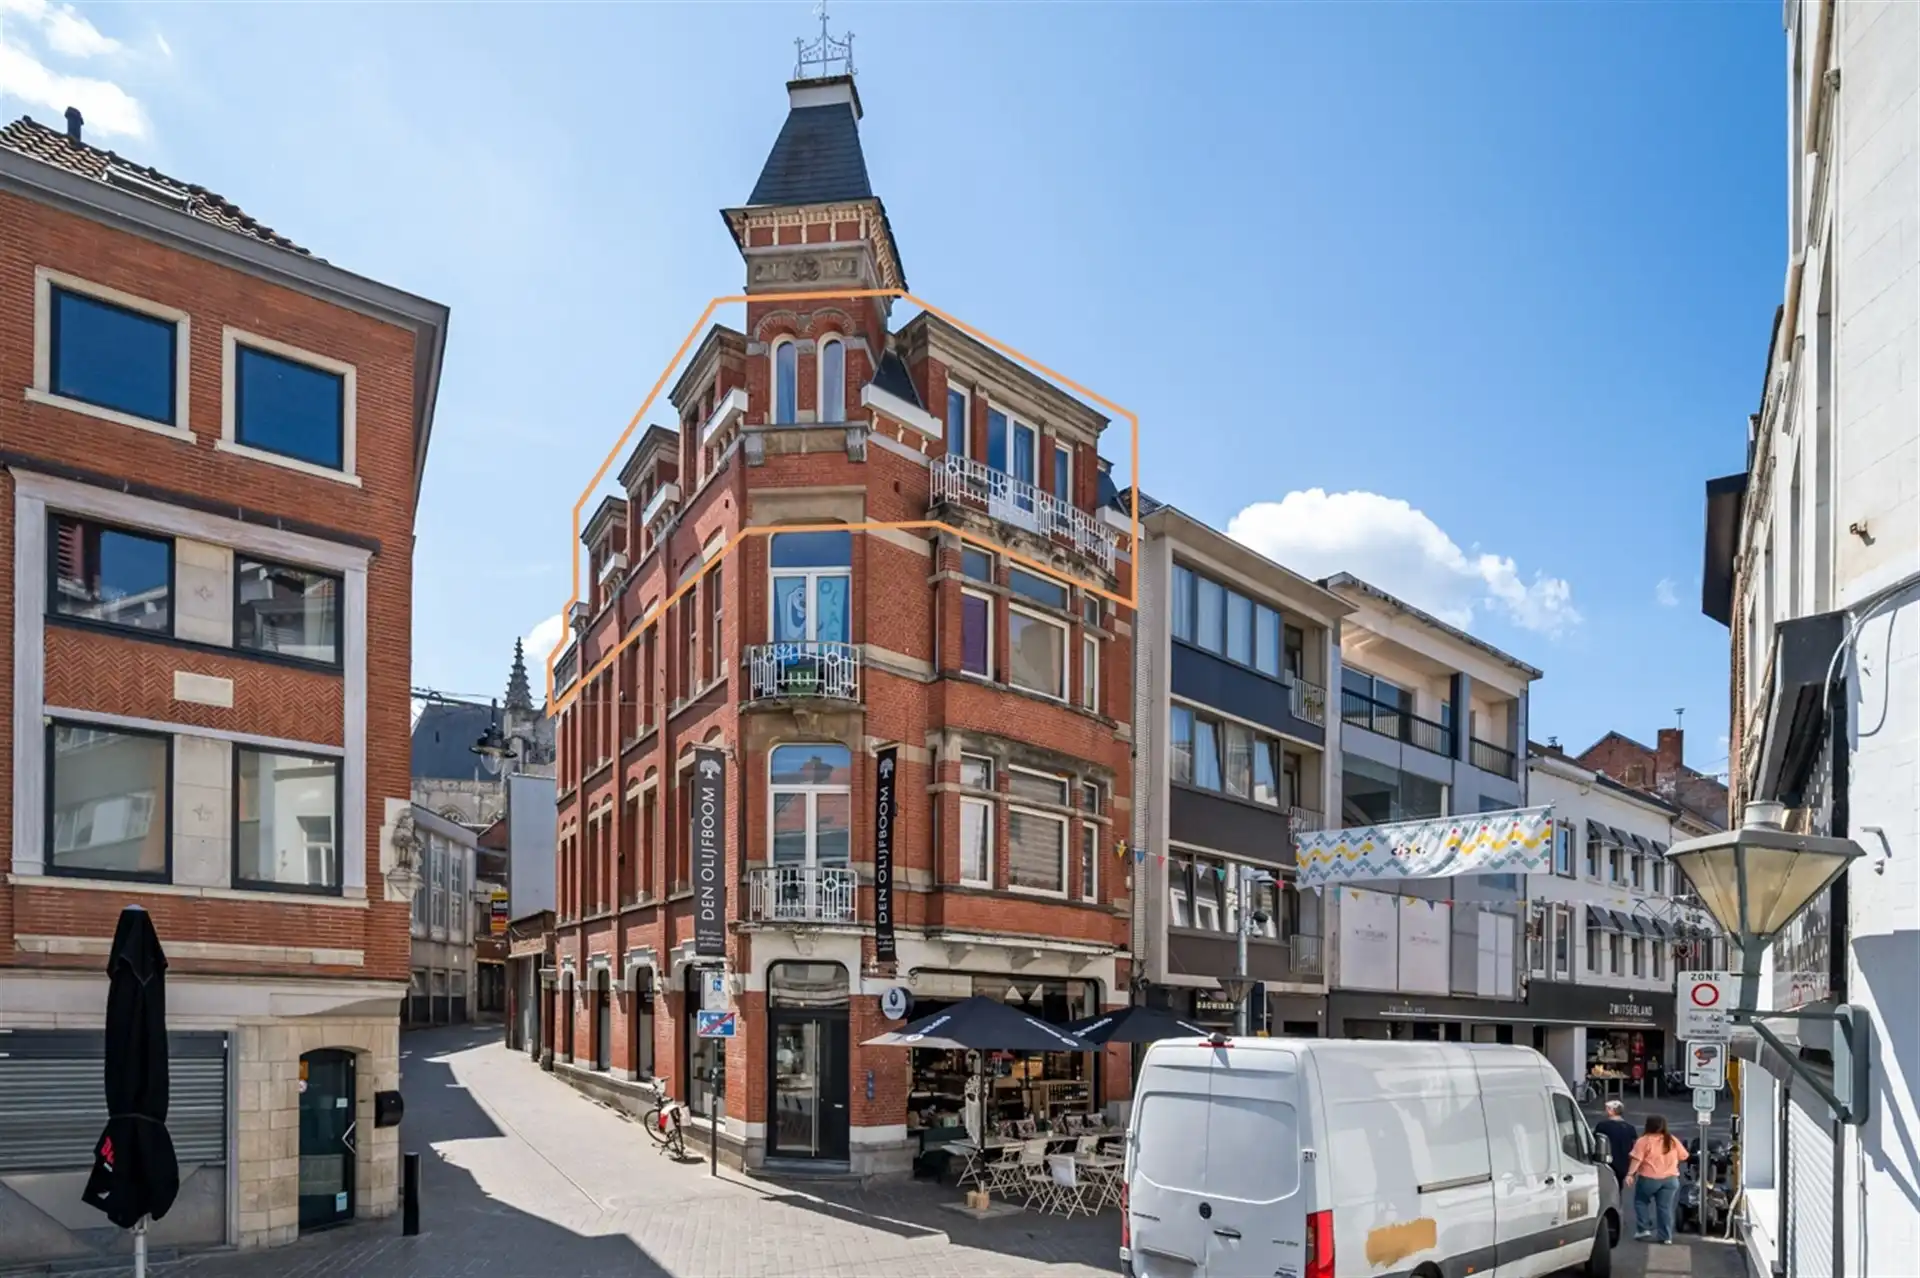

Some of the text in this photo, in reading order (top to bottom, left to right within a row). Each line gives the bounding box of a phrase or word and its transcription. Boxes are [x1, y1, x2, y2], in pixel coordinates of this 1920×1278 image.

[700, 787, 719, 882] OLIJFBOOM
[877, 785, 889, 883] OLIJFBOOM
[701, 886, 715, 921] DEN
[877, 888, 888, 924] DEN
[1690, 972, 1721, 982] ZONE
[1608, 1002, 1654, 1016] ZWITSERLAND
